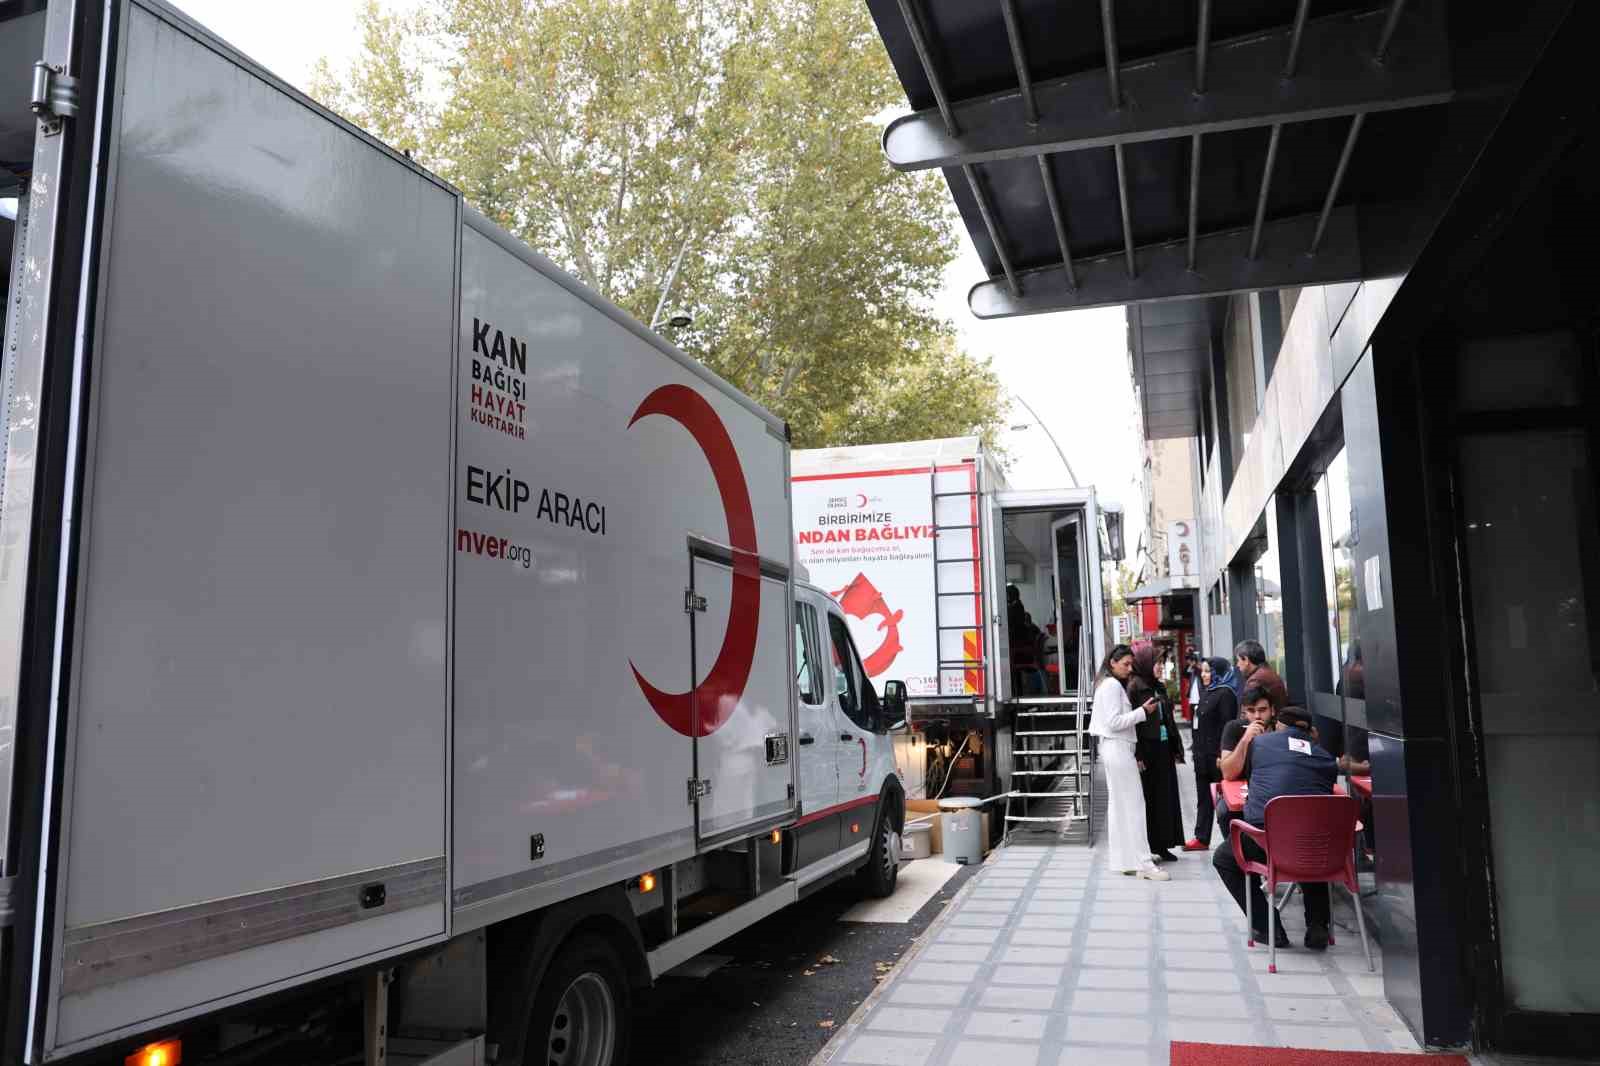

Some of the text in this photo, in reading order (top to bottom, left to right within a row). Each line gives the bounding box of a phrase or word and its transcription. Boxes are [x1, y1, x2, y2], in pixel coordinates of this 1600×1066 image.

[472, 317, 527, 375] KAN
[471, 359, 526, 402] BAĞIŞI
[471, 384, 526, 422] HAYAT
[470, 408, 526, 441] KURTARIR
[466, 465, 606, 535] EKİP ARACI
[818, 511, 892, 526] BİRBİRİMİZE
[457, 527, 531, 569] nver.org
[855, 523, 940, 541] BAĞLIYIZ
